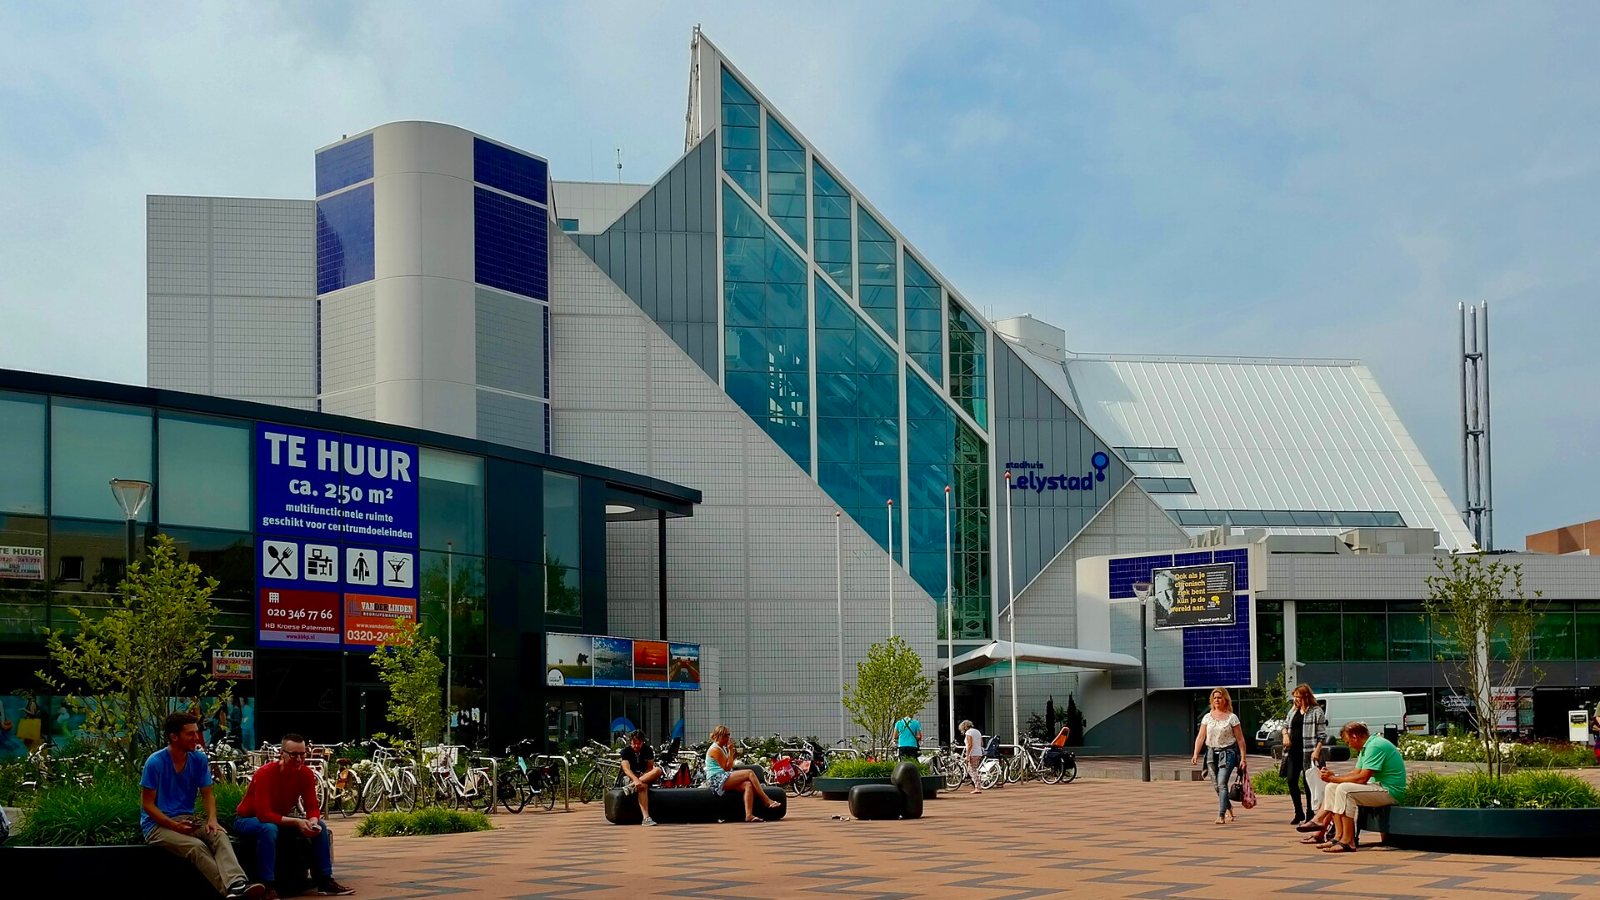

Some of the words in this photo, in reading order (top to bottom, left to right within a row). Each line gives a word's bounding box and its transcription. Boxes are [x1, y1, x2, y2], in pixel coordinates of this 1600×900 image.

[264, 431, 307, 469] TE
[317, 439, 412, 482] HUUR
[1005, 460, 1044, 469] stadhuis
[289, 479, 319, 496] ca.
[324, 483, 363, 504] 250
[368, 487, 394, 504] m²
[285, 503, 364, 520] multifunctionele
[365, 512, 394, 523] ruimte
[262, 516, 304, 527] geschikt
[305, 520, 327, 530] voor
[327, 521, 413, 539] centrumdoeleinden
[13, 548, 42, 556] HUUR
[1199, 571, 1206, 579] je
[1190, 596, 1197, 604] je
[267, 608, 286, 617] 020
[287, 608, 306, 620] 346
[307, 610, 319, 620] 77
[320, 609, 333, 619] 66
